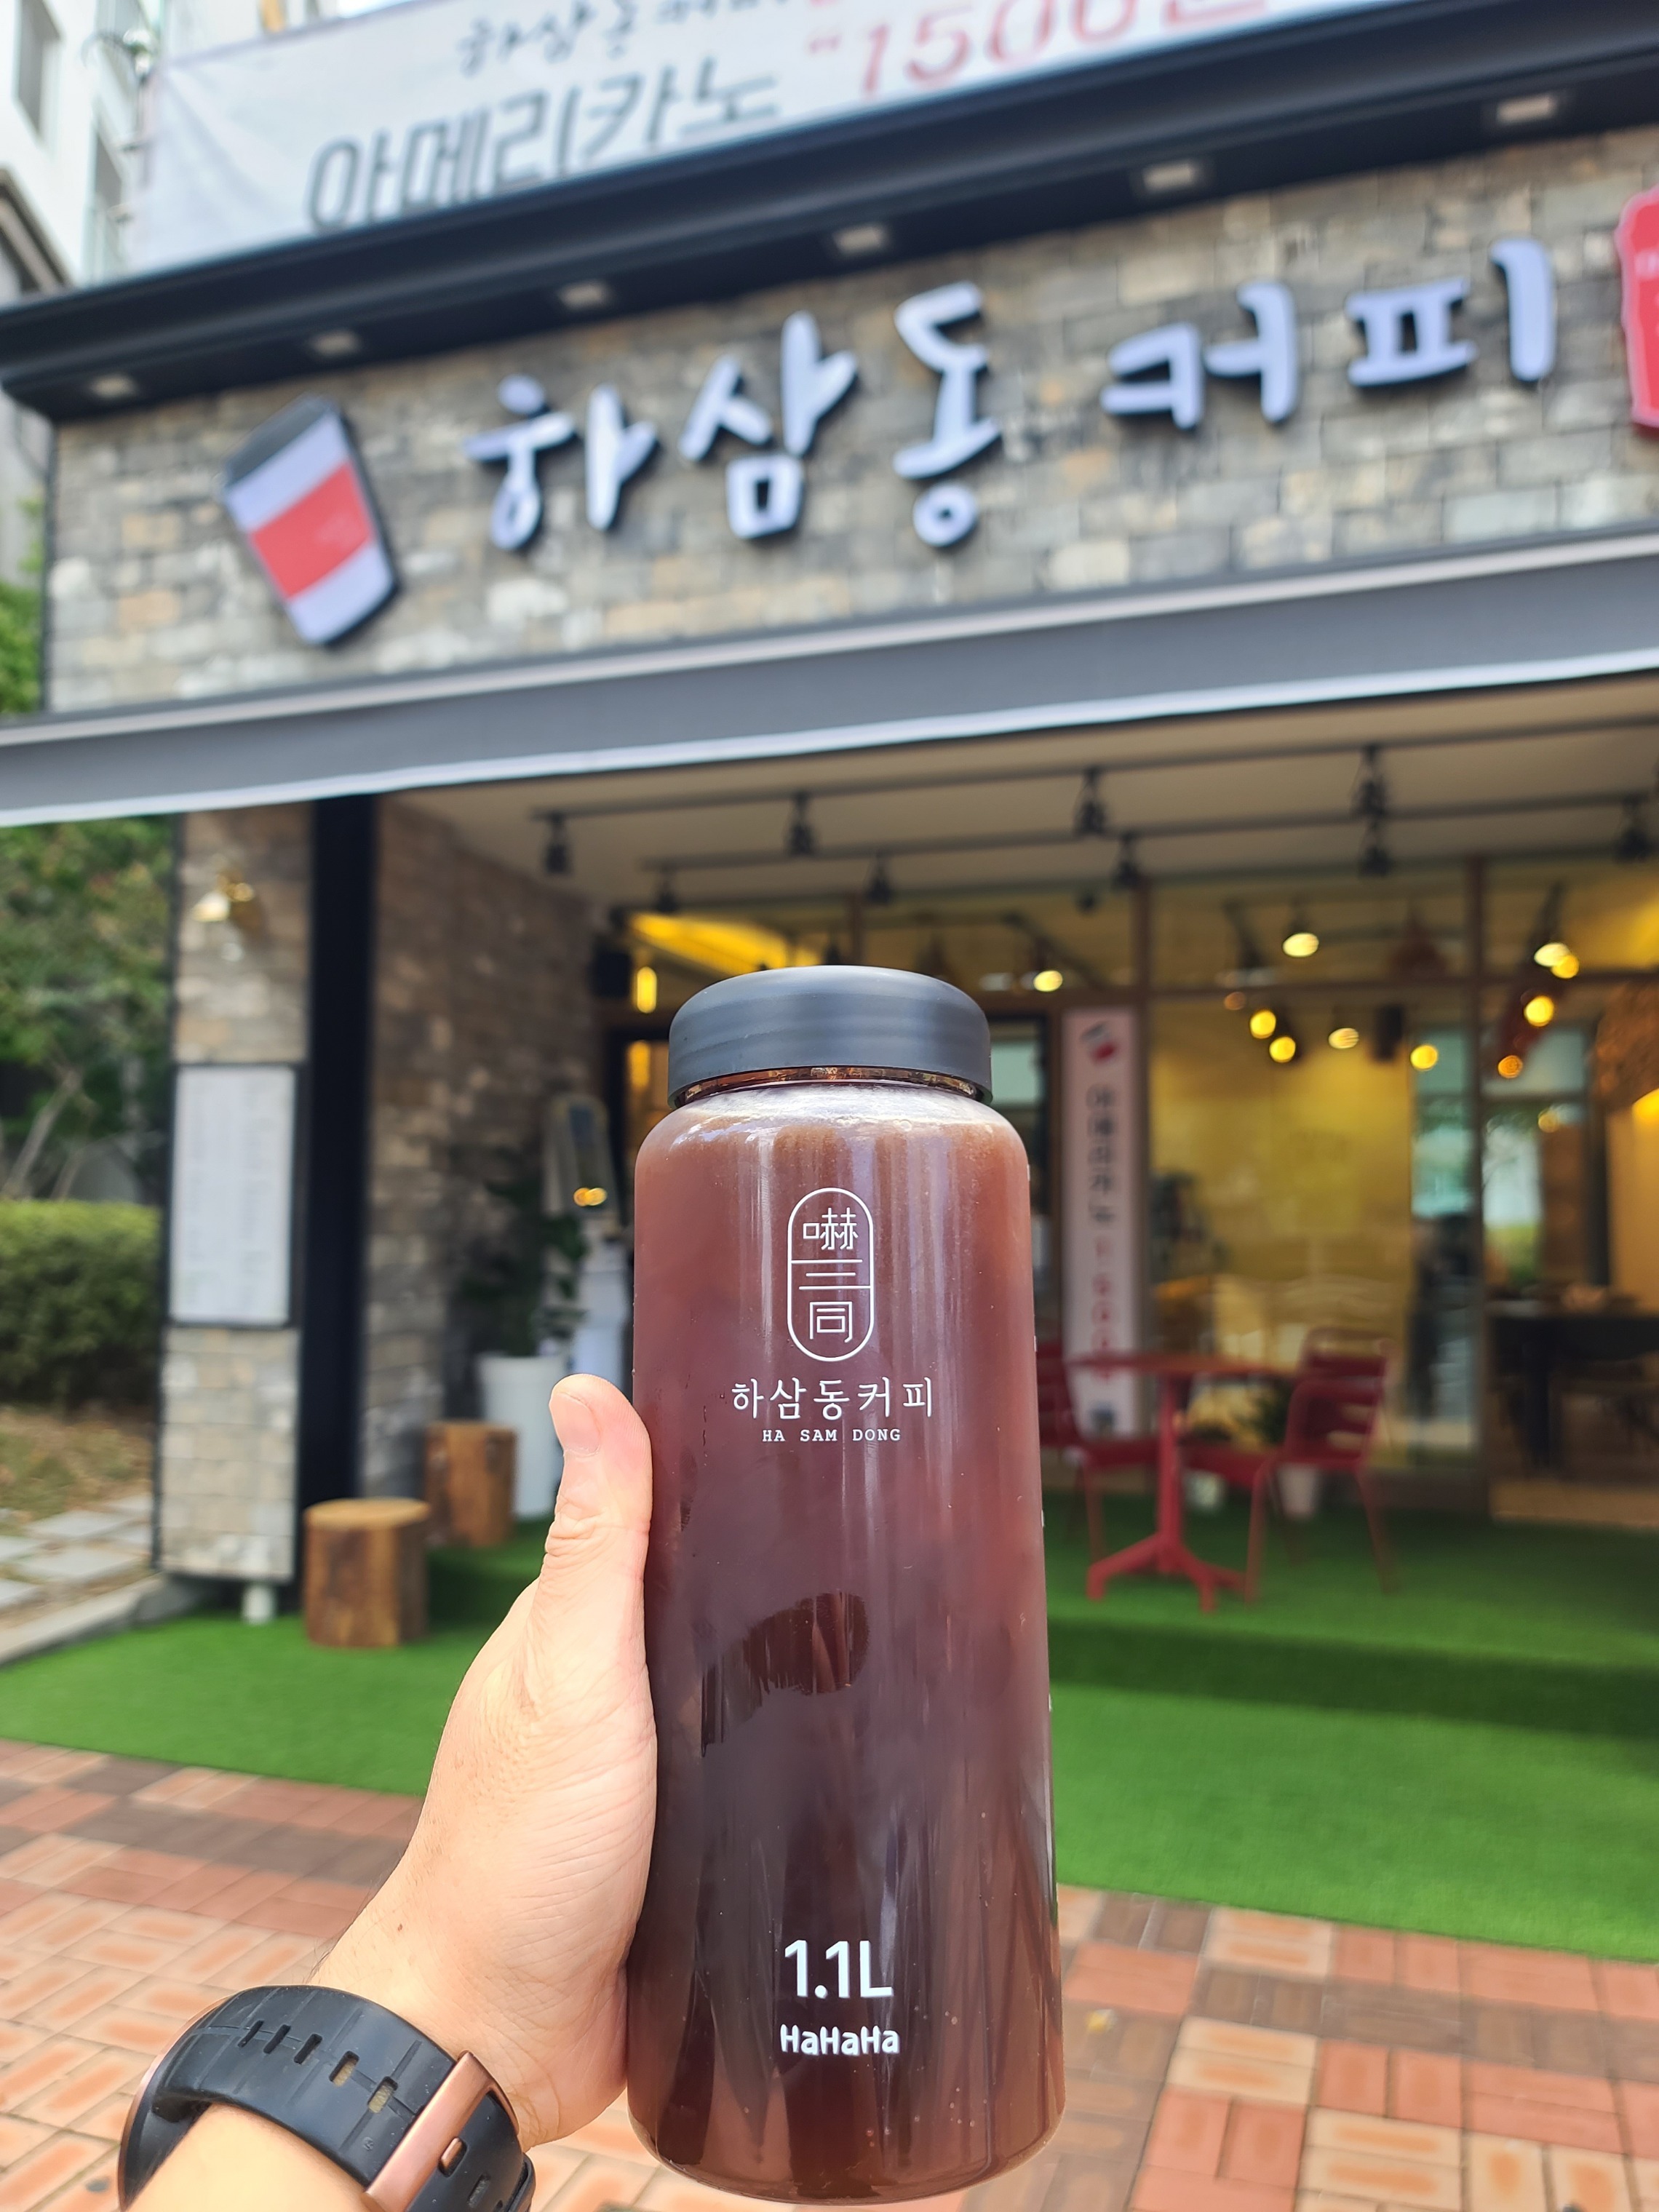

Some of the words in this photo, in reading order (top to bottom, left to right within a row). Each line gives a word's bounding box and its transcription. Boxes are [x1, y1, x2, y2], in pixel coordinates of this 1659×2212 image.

[306, 56, 784, 233] 아메리카노
[462, 279, 1003, 549] 하삼동
[1099, 236, 1557, 431] 커피
[762, 1429, 786, 1442] HA
[800, 1429, 838, 1442] SAM
[852, 1428, 902, 1441] DONG
[784, 1939, 895, 1999] 1.1L
[780, 2024, 900, 2056] HaHaHa
